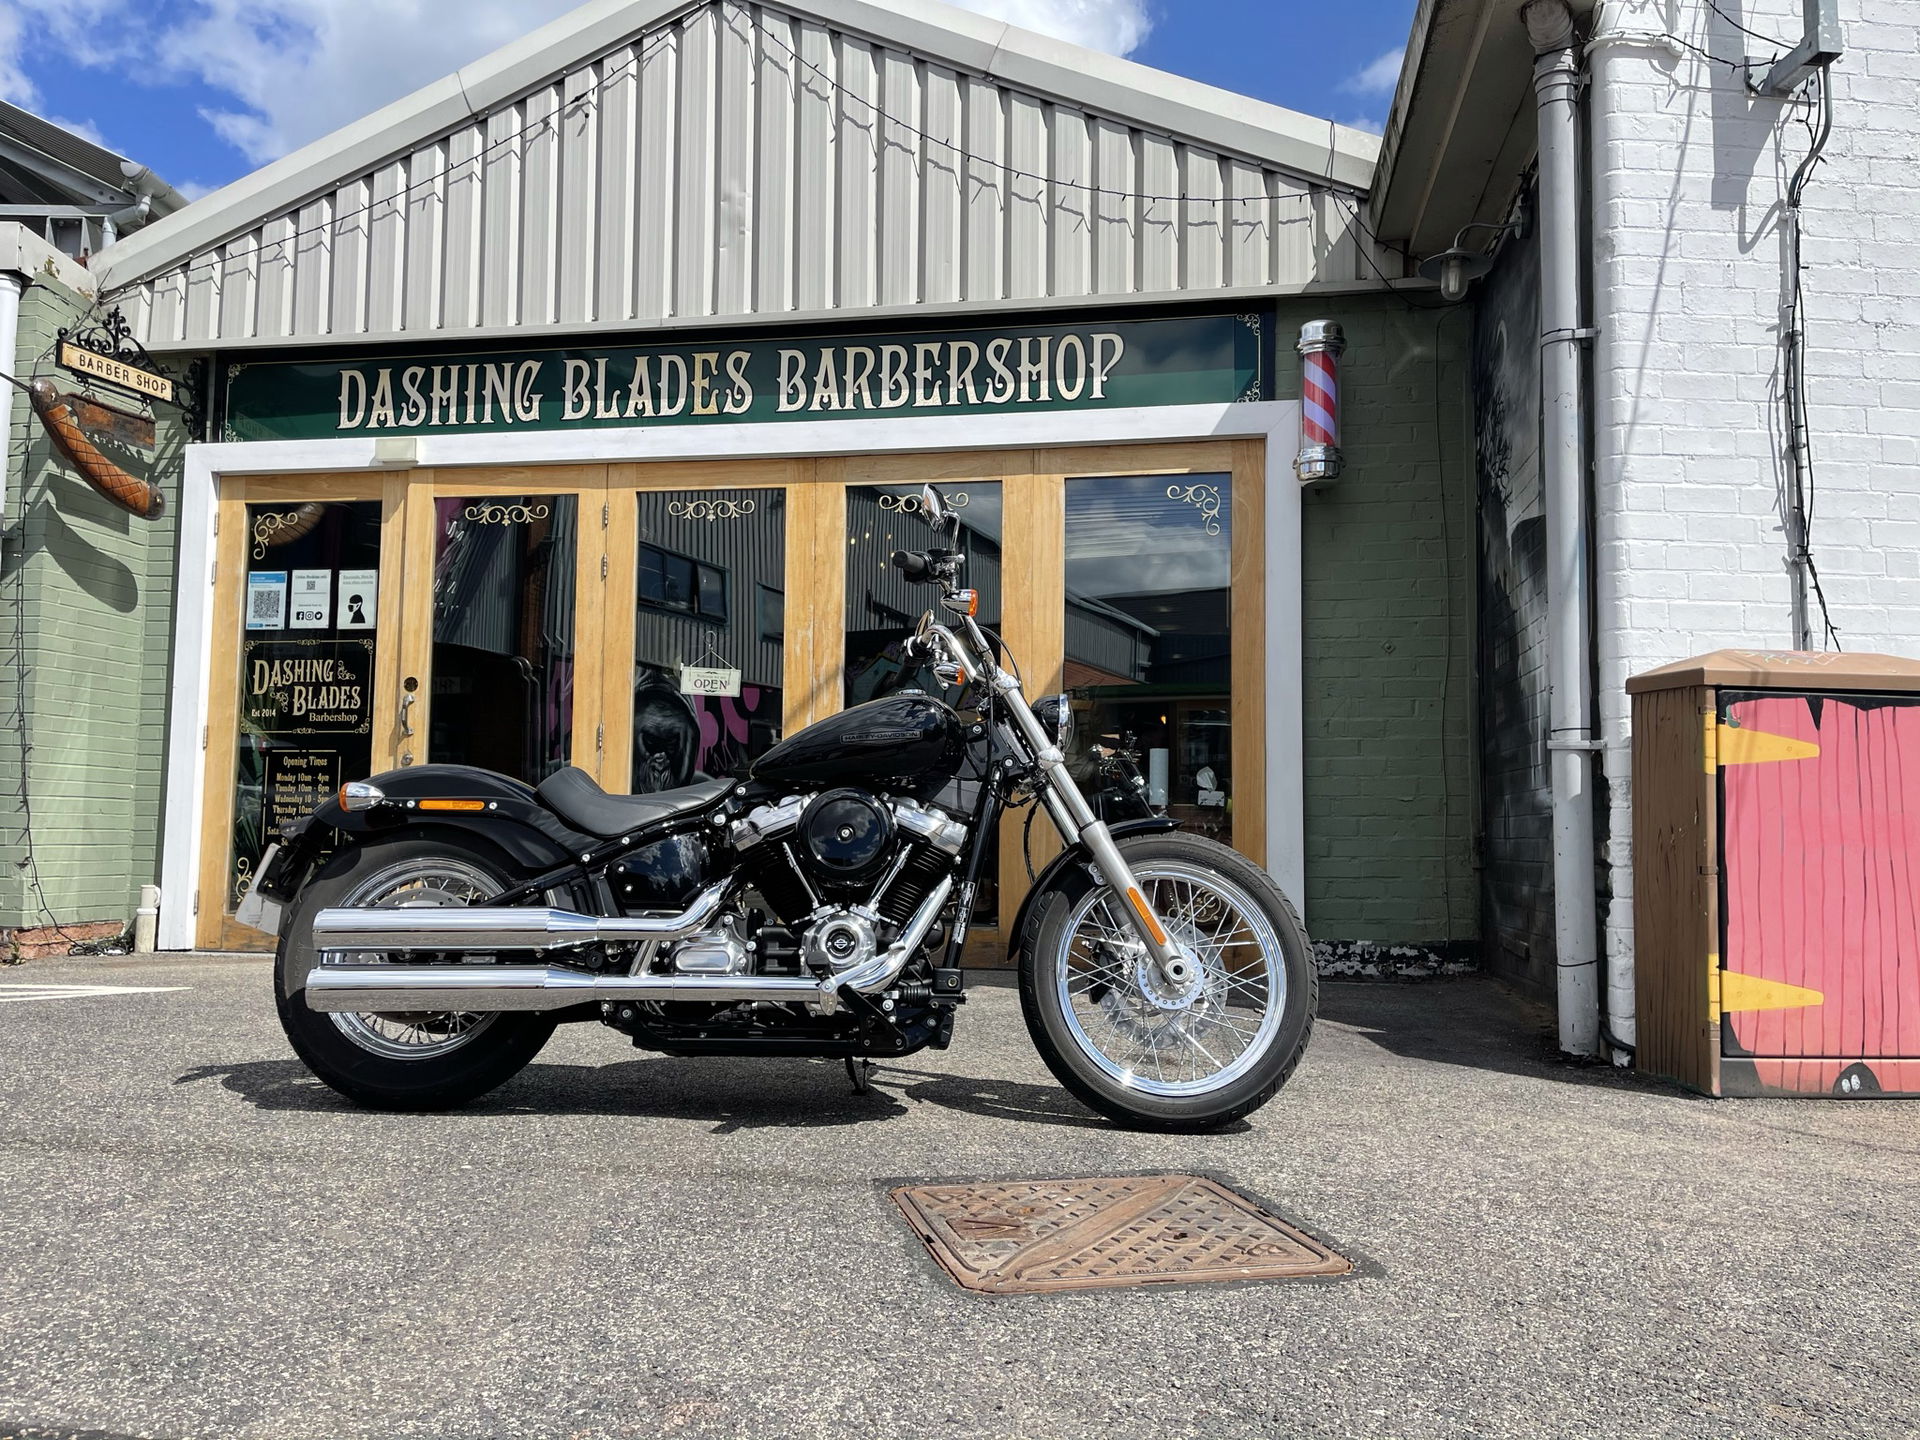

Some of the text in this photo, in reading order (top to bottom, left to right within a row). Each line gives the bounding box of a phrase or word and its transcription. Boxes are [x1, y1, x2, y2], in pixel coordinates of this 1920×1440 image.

[79, 354, 167, 394] BARBER SHOP
[337, 332, 1126, 430] DASHING BLADES BARBERSHOP
[252, 659, 335, 695] DASHING
[693, 678, 728, 690] OPEN
[292, 685, 361, 716] BLADES
[251, 708, 276, 717] Est 2014
[308, 712, 358, 724] Barbershop
[283, 755, 328, 768] Opening Times
[276, 772, 296, 783] Monday
[298, 772, 312, 782] 10am
[317, 772, 330, 783] 4pm
[275, 783, 296, 793] Tuesday
[298, 783, 313, 792] 10am
[274, 794, 303, 804] Wednesday
[304, 794, 312, 803] 10
[272, 804, 297, 815] Thursday
